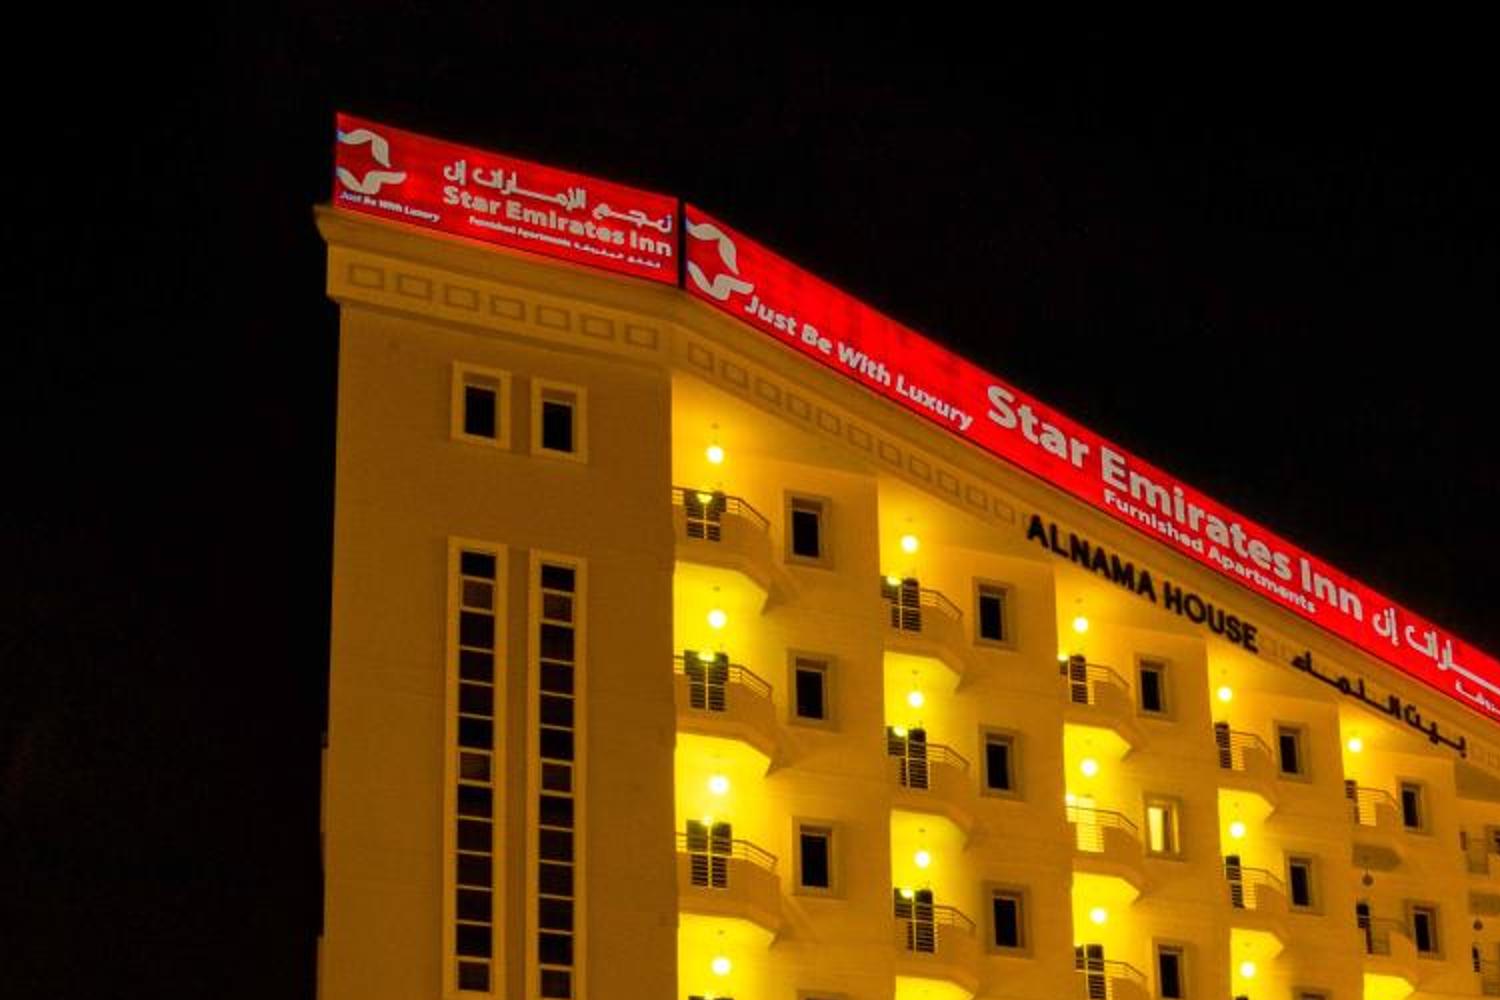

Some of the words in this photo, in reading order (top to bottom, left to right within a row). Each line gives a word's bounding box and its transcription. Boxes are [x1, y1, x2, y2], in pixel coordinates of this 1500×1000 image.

[444, 186, 501, 215] Star
[506, 200, 624, 246] Emirates
[629, 229, 672, 257] Inn
[592, 203, 673, 234] نجم
[744, 296, 796, 335] Just
[801, 323, 833, 354] Be
[837, 341, 891, 386] With
[896, 374, 973, 431] Luxury
[987, 385, 1089, 469] Star
[1101, 446, 1292, 581] Emirates
[1300, 557, 1363, 621] Inn
[1103, 488, 1204, 554] Furnished
[1208, 545, 1317, 613] Apartments
[1027, 514, 1156, 603] ALNAMA
[1163, 581, 1258, 654] HOUSE
